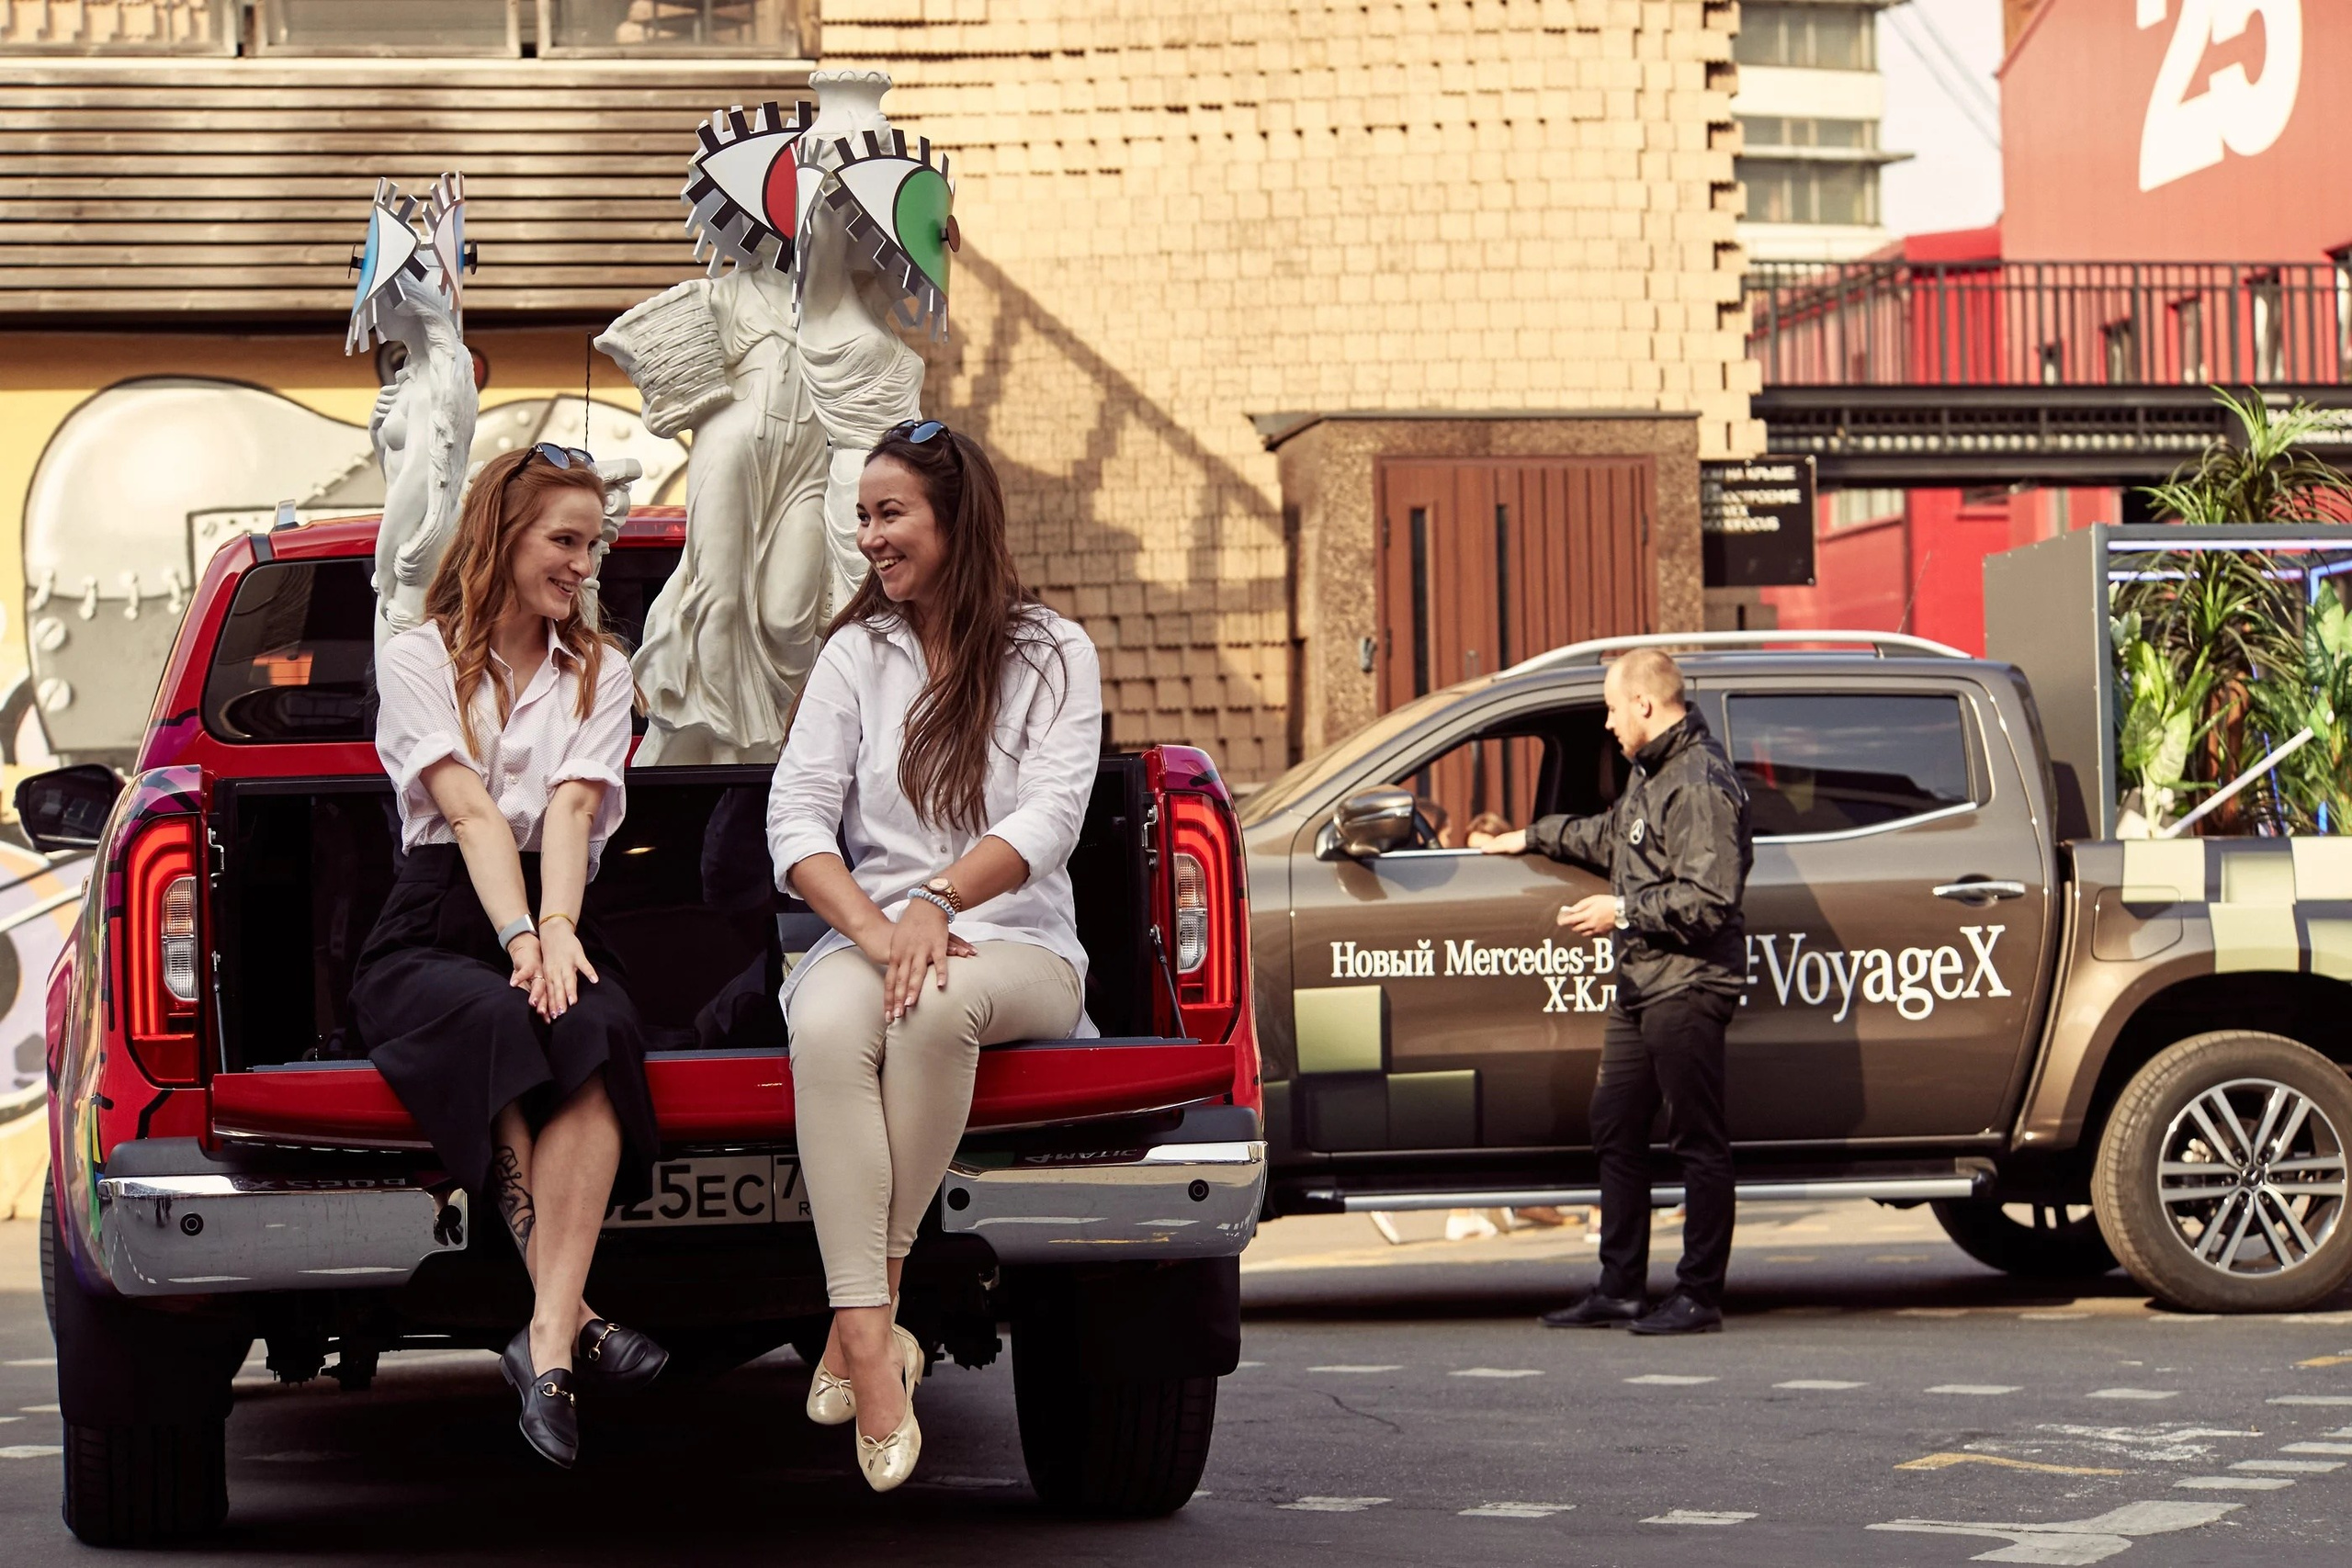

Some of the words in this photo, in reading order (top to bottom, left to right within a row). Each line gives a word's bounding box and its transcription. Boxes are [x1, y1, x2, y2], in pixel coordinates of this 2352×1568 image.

[2136, 0, 2303, 193] 25
[1329, 938, 1435, 978] Новый
[1443, 937, 1615, 976] Mercedes-B
